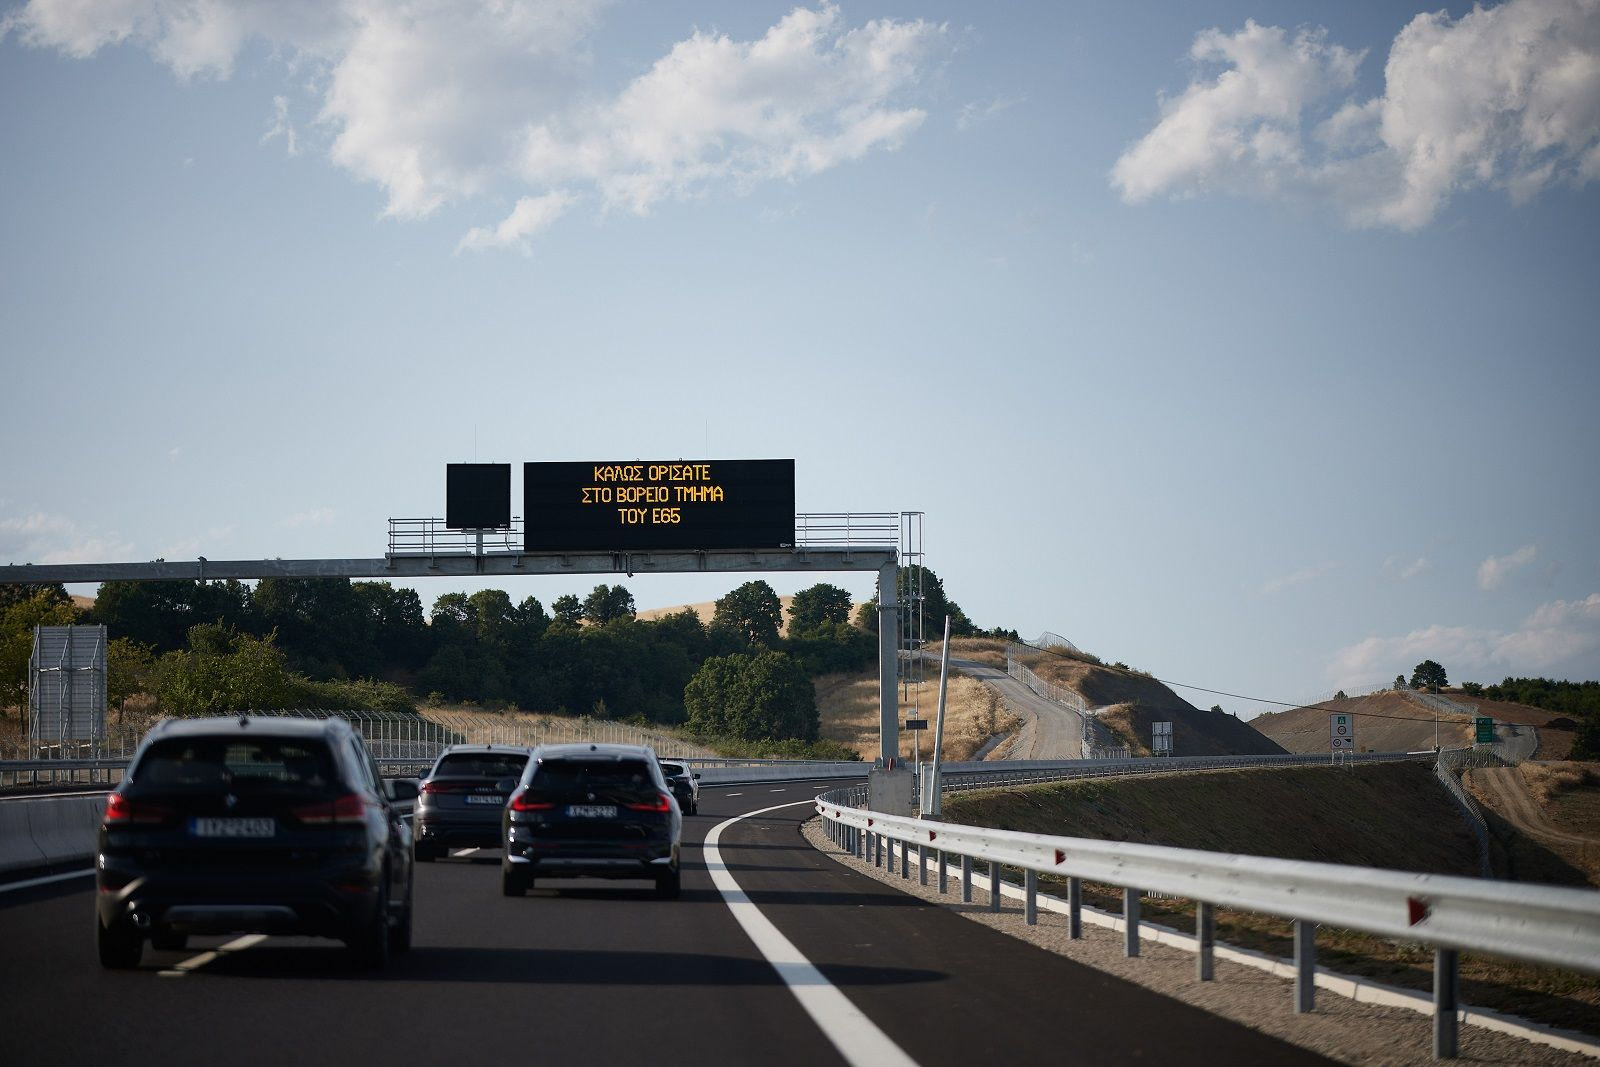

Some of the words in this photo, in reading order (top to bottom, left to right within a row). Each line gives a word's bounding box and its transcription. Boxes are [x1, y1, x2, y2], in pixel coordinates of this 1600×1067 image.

[594, 465, 644, 482] ΚΑΛΩΣ
[648, 464, 711, 481] ΟΡΙΣΑΤΕ
[582, 487, 612, 504] ΣΤΟ
[616, 486, 669, 503] ΒΟΡΕΙΟ
[674, 485, 724, 502] ΤΜΗΜΑ
[618, 508, 648, 524] ΤΟΥ
[652, 507, 681, 524] Ε65
